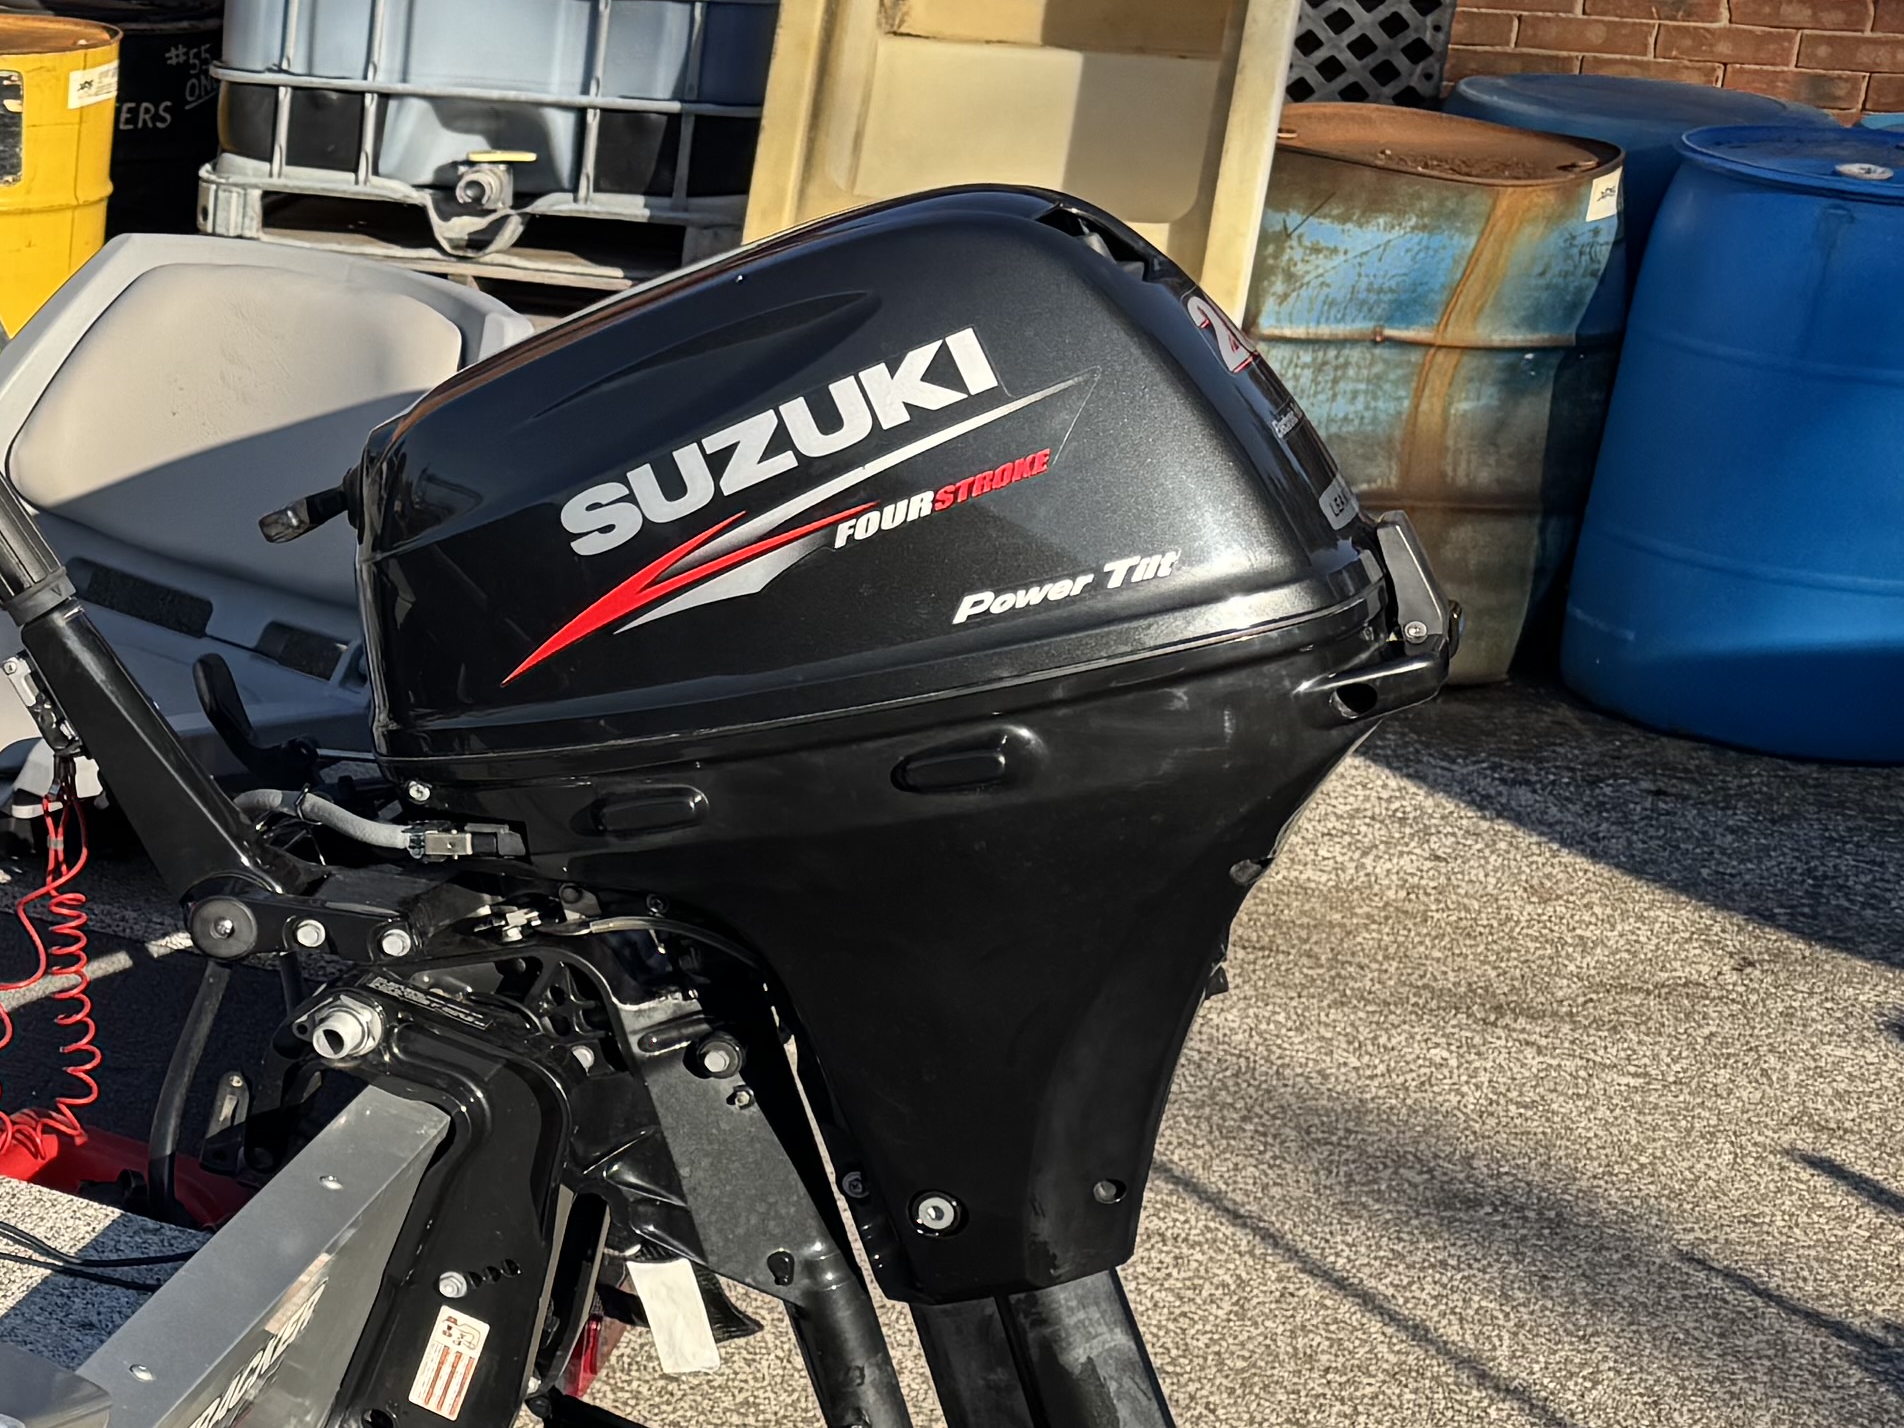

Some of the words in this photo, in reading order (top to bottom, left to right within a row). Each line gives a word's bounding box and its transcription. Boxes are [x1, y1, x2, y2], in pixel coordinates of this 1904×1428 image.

[185, 75, 220, 102] ON
[116, 101, 173, 130] ERS
[560, 326, 999, 557] SUZUKI
[951, 571, 1094, 625] Power
[1102, 547, 1180, 589] Tilt
